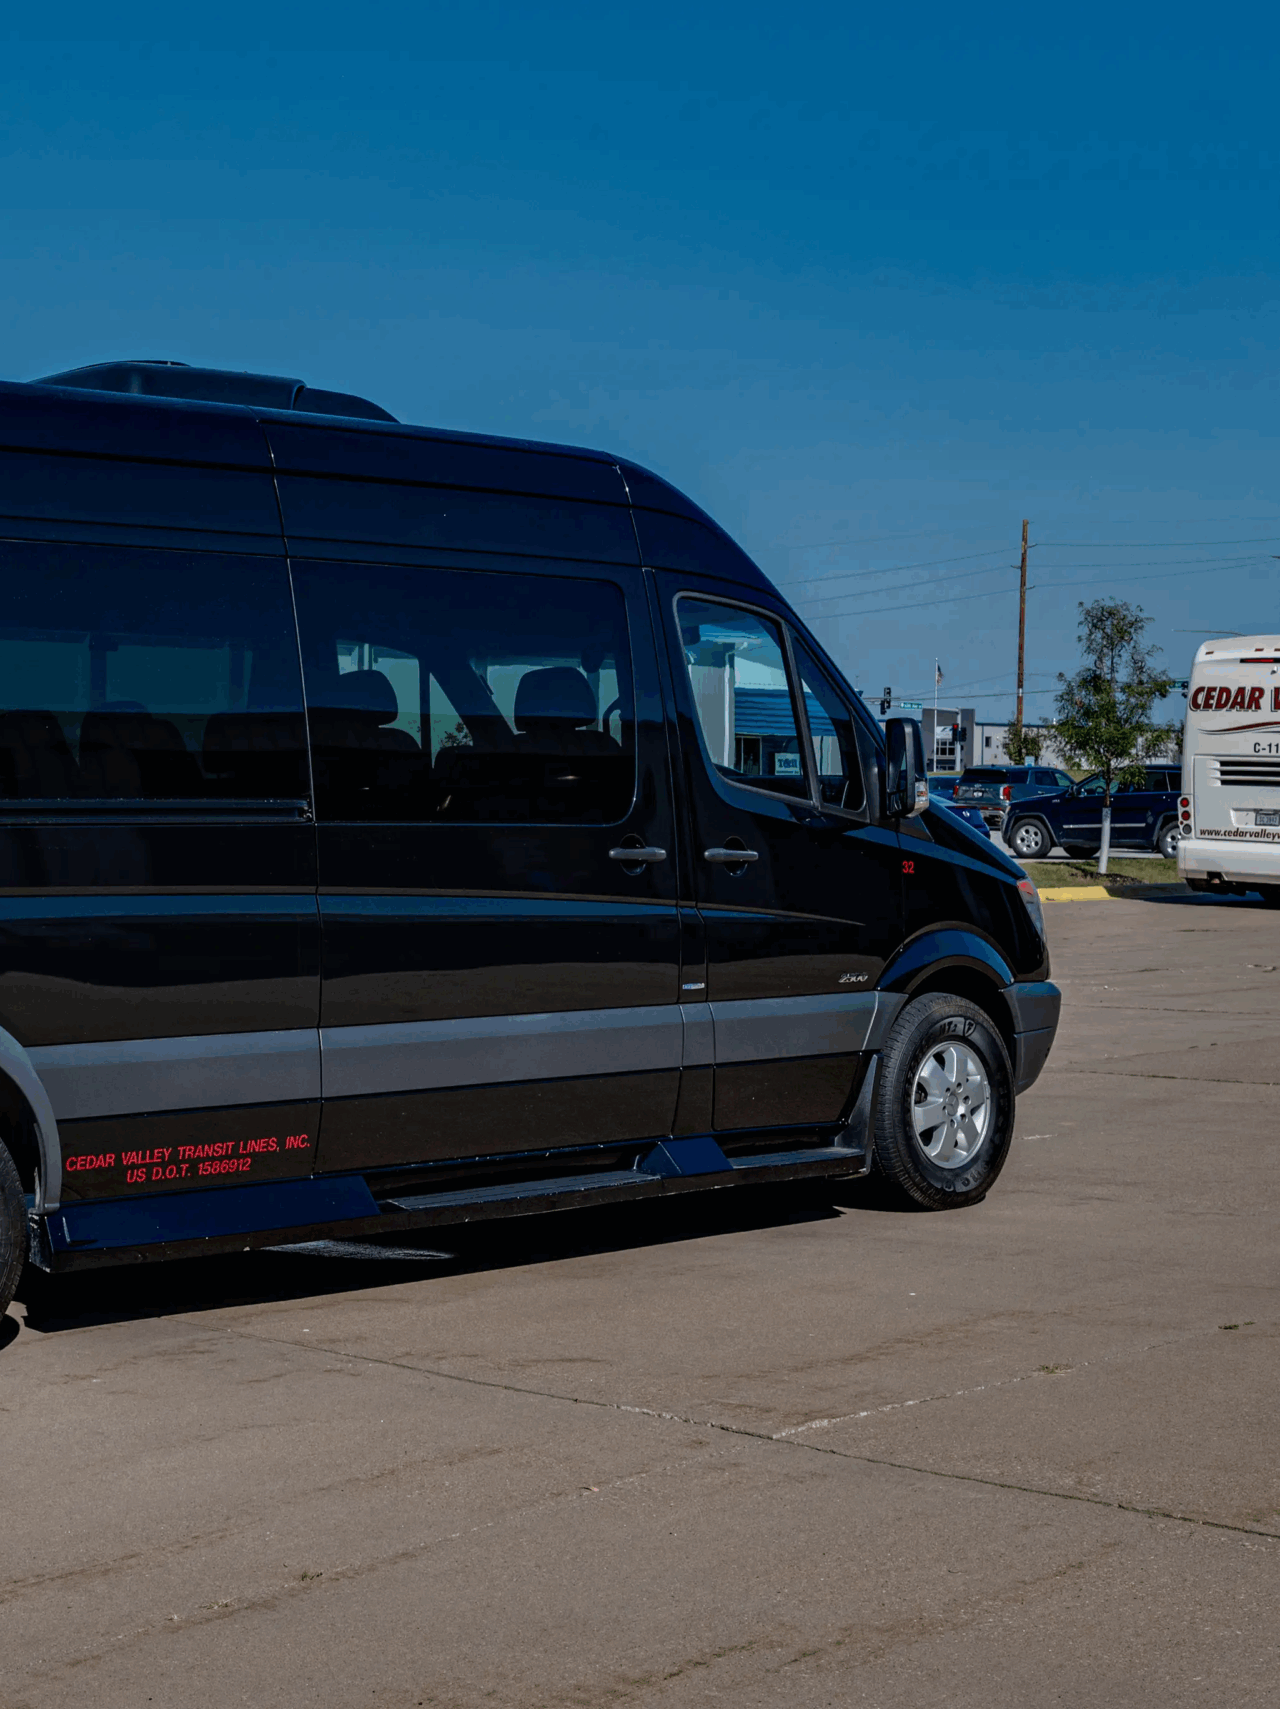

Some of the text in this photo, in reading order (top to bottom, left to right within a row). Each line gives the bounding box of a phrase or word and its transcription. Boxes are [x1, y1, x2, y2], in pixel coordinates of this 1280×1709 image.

[1189, 686, 1265, 712] CEDAR
[902, 860, 915, 873] 32
[65, 1134, 311, 1171] CEDAR VALLEY TRANSIT LINES, INC.
[126, 1158, 252, 1183] US D.O.T. 1586912
